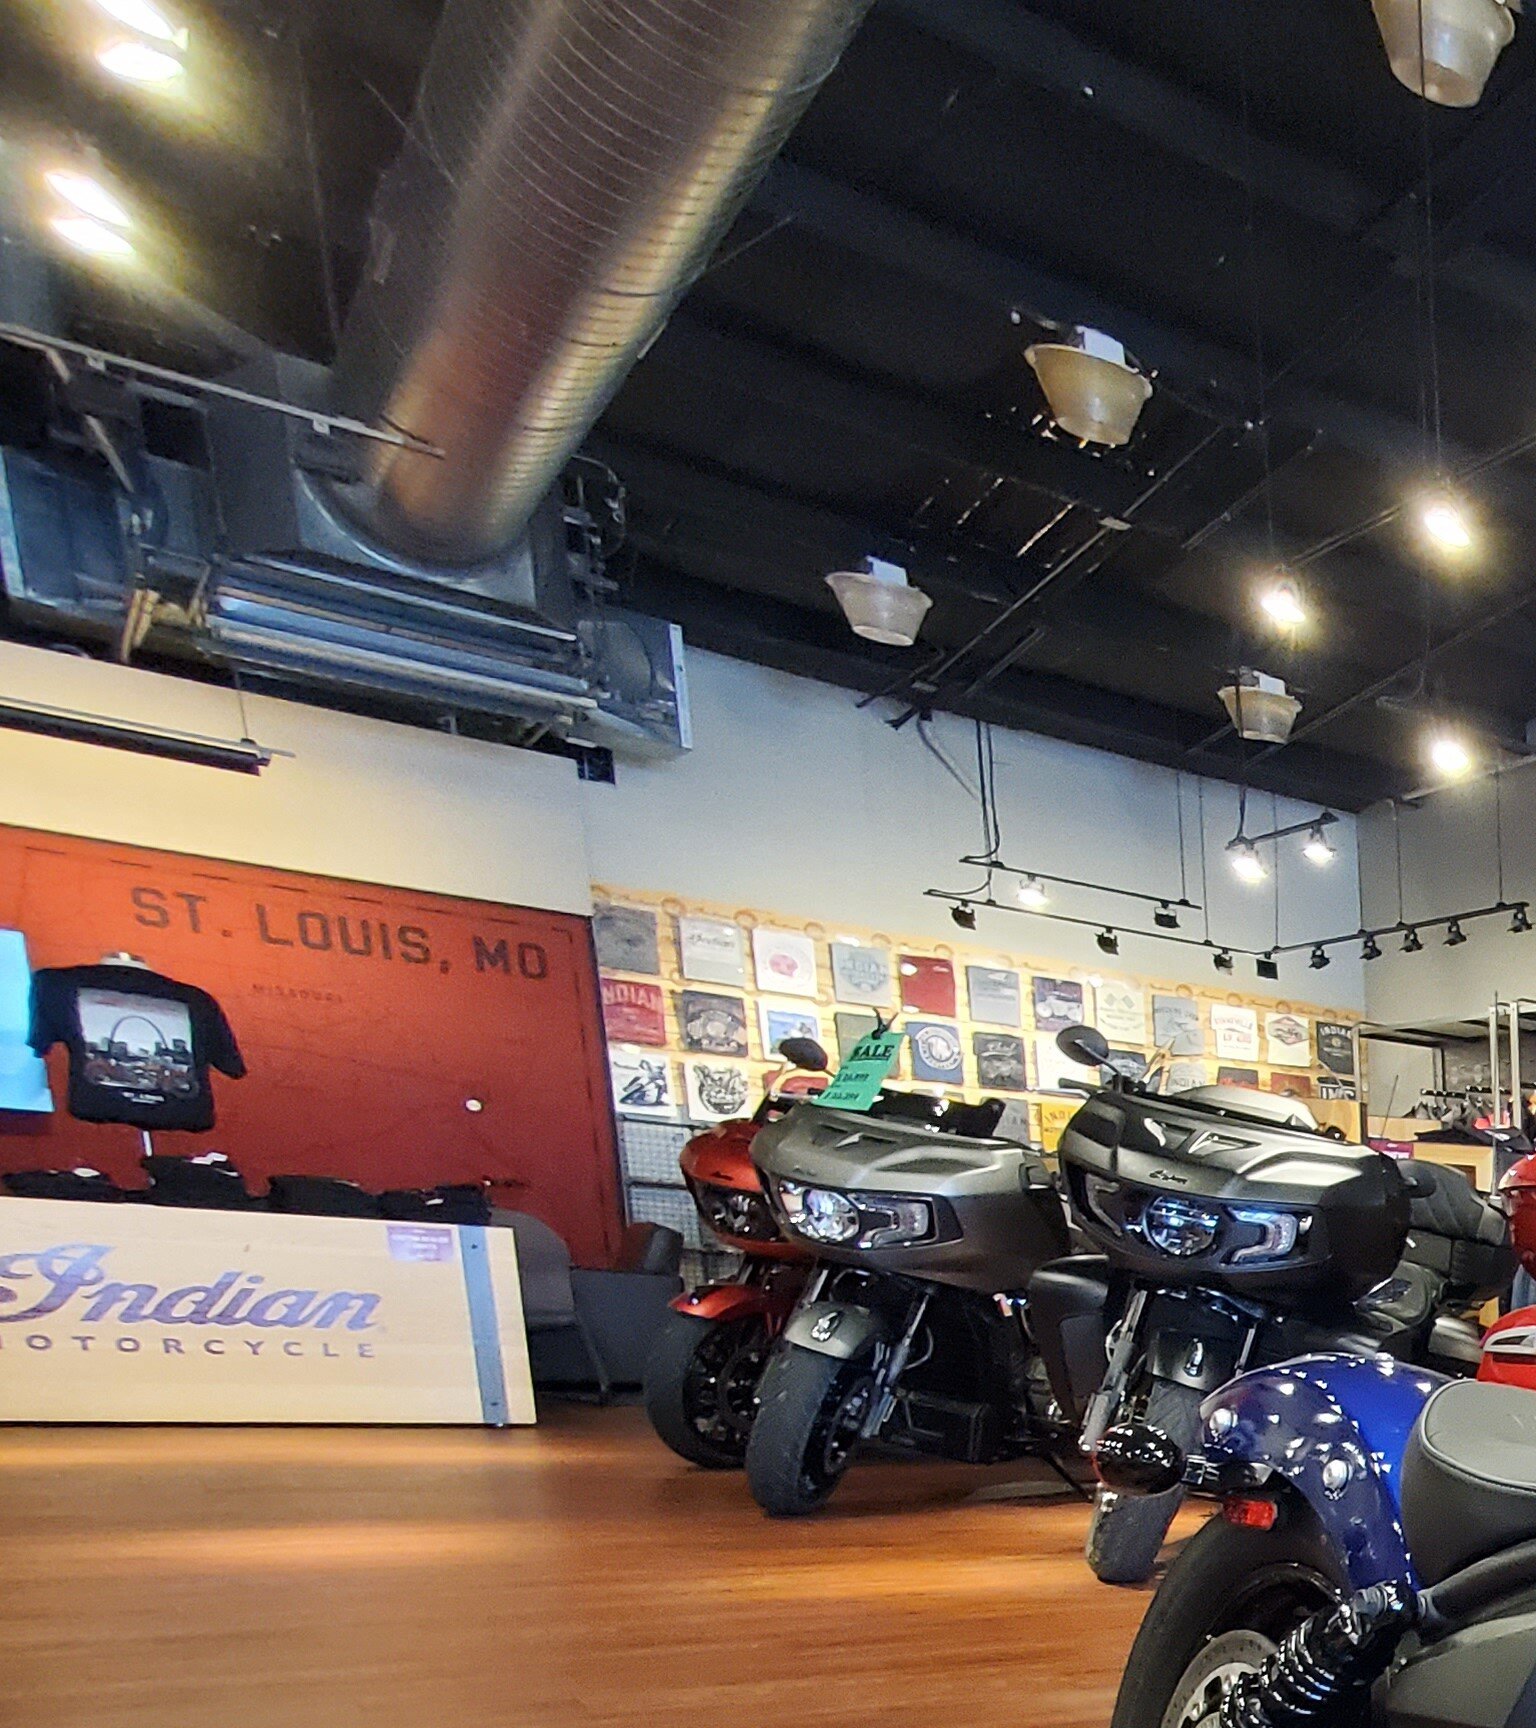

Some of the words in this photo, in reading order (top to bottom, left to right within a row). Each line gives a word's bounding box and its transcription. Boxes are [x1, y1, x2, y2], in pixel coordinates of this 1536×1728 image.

[131, 886, 233, 938] ST.
[255, 903, 452, 976] LOUIS,
[472, 935, 549, 981] MO
[0, 1242, 384, 1332] Indian
[0, 1334, 377, 1359] OTORCYCLE
